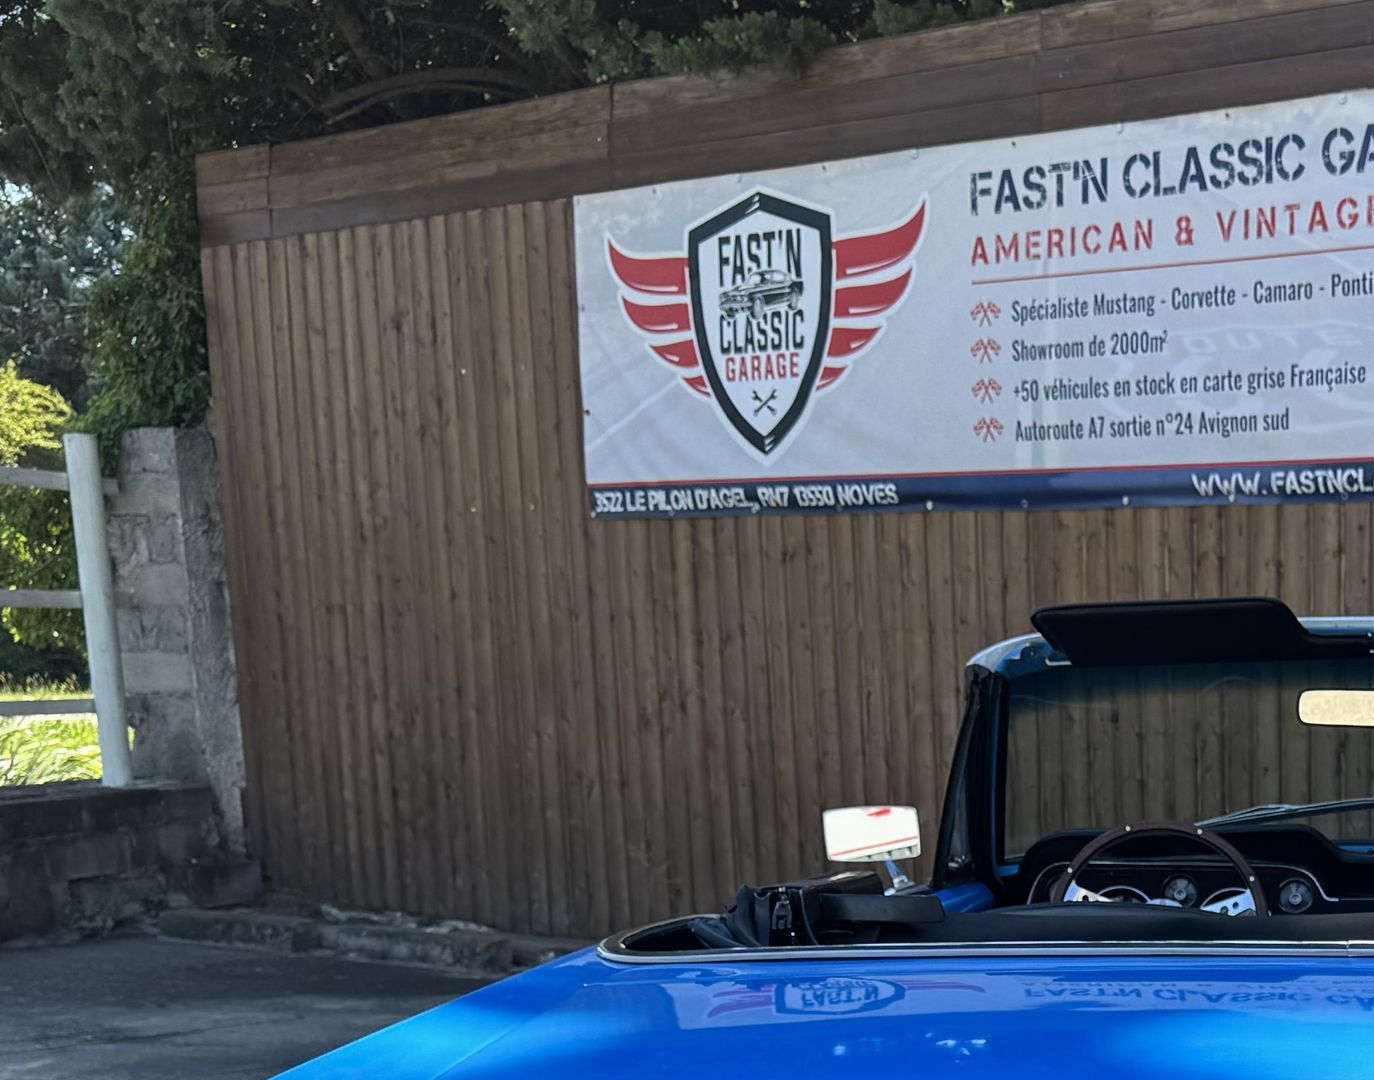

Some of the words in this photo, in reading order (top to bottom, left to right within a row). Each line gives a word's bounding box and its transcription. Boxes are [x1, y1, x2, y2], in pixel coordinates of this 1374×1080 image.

[969, 157, 1109, 217] FAST'N
[1122, 133, 1305, 201] CLASSIC
[718, 228, 802, 287] FAST'N
[971, 217, 1154, 267] AMERICAN
[1174, 215, 1194, 247] &
[1011, 295, 1088, 327] Spécialiste
[1093, 290, 1155, 321] Mustang
[1171, 285, 1236, 312] Corvette
[1253, 278, 1313, 305] Camaro
[720, 308, 804, 355] CLASSIC
[1012, 334, 1085, 362] Showroom
[1088, 334, 1106, 359] de
[1110, 330, 1168, 356] 2000m²
[725, 352, 800, 382] GARAGE
[1013, 380, 1039, 404] +50
[1043, 373, 1110, 401] véhicules
[1114, 378, 1132, 397] en
[1135, 368, 1175, 396] stock
[1180, 374, 1199, 394] en
[1203, 368, 1243, 393] carte
[1247, 365, 1286, 397] grise
[1290, 362, 1367, 392] Française
[1015, 416, 1084, 443] Autoroute
[1088, 415, 1105, 440] A7
[1109, 414, 1152, 438] sortie
[1156, 411, 1194, 436] n°24
[1199, 409, 1258, 437] Avignon
[1261, 407, 1290, 431] sud
[625, 490, 647, 512] LE
[836, 483, 899, 506] NOVES
